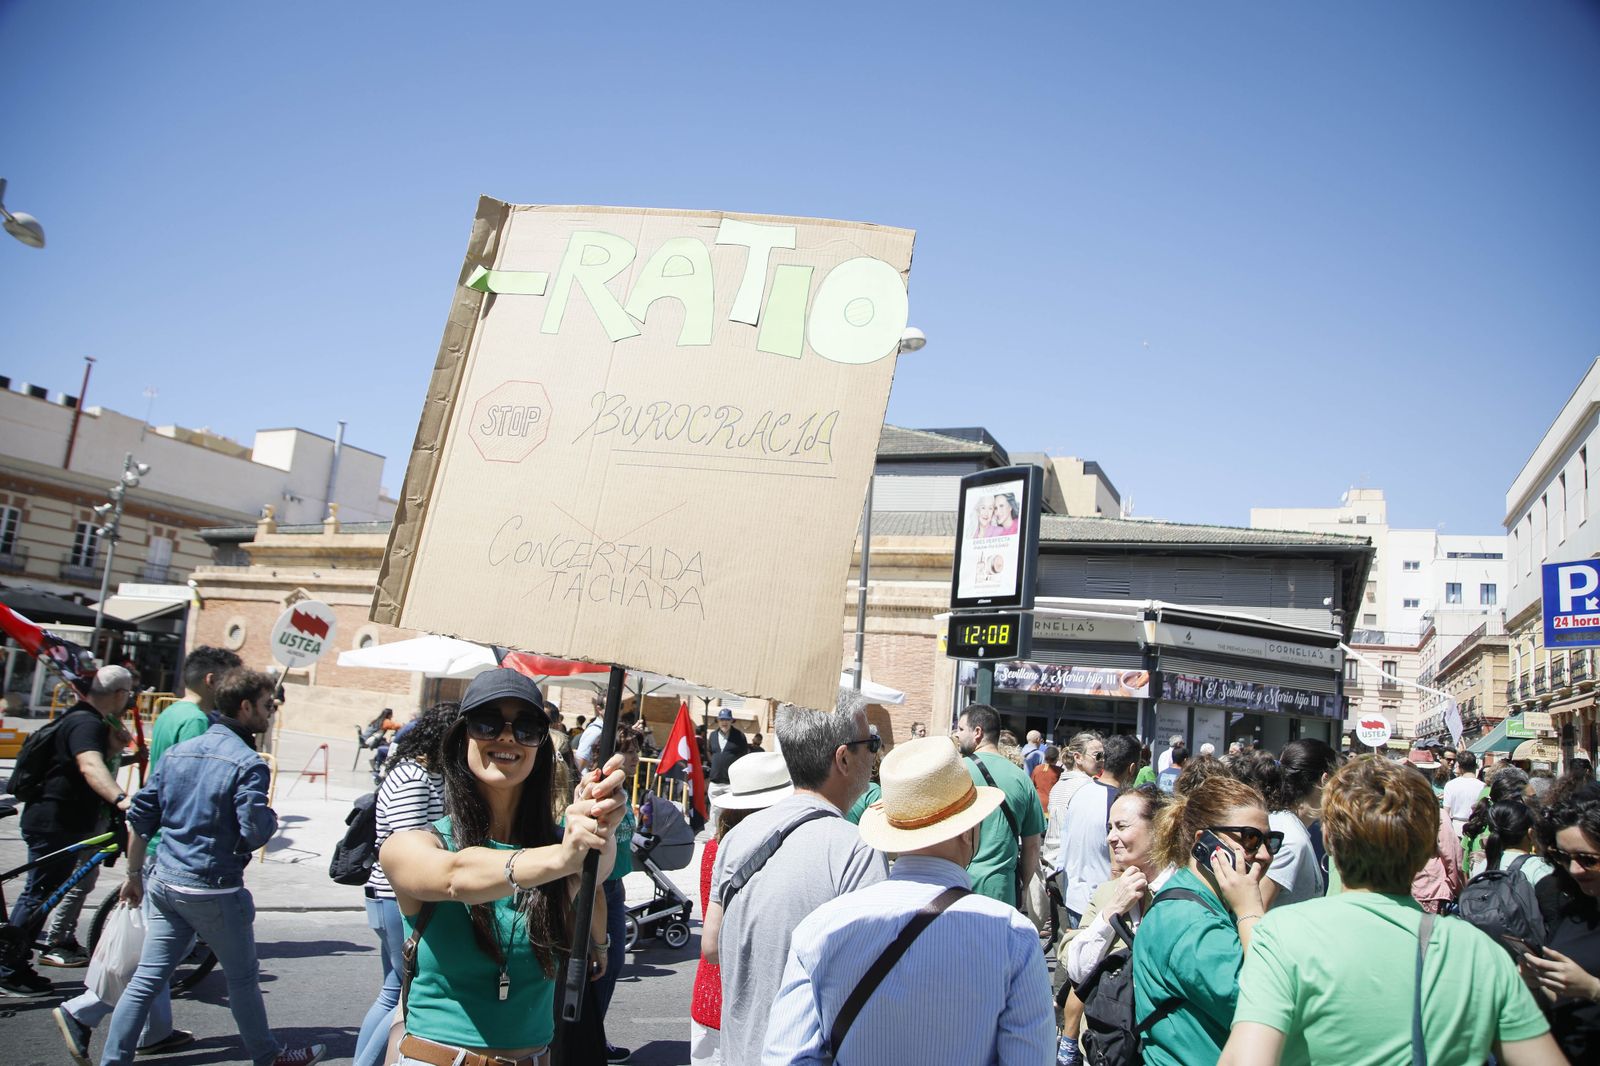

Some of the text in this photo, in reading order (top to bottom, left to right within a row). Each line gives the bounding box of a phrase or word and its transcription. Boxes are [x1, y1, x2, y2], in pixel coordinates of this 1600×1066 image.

[480, 404, 542, 437] STOP
[488, 514, 705, 586] CONCERTADA
[547, 570, 705, 620] TACHADA
[1558, 564, 1599, 612] P
[1034, 619, 1095, 632] RNELIA'S
[1554, 614, 1600, 628] 24 hora
[278, 631, 321, 656] USTEA
[964, 624, 1010, 645] 12:08
[1269, 643, 1323, 660] CORNELIA'S
[1000, 667, 1039, 681] Sevillano
[1206, 681, 1218, 698] El
[1218, 683, 1256, 700] Sevillano
[1257, 692, 1262, 705] y
[1294, 691, 1309, 710] hija
[1311, 695, 1319, 707] III
[1362, 730, 1386, 738] USTEA
